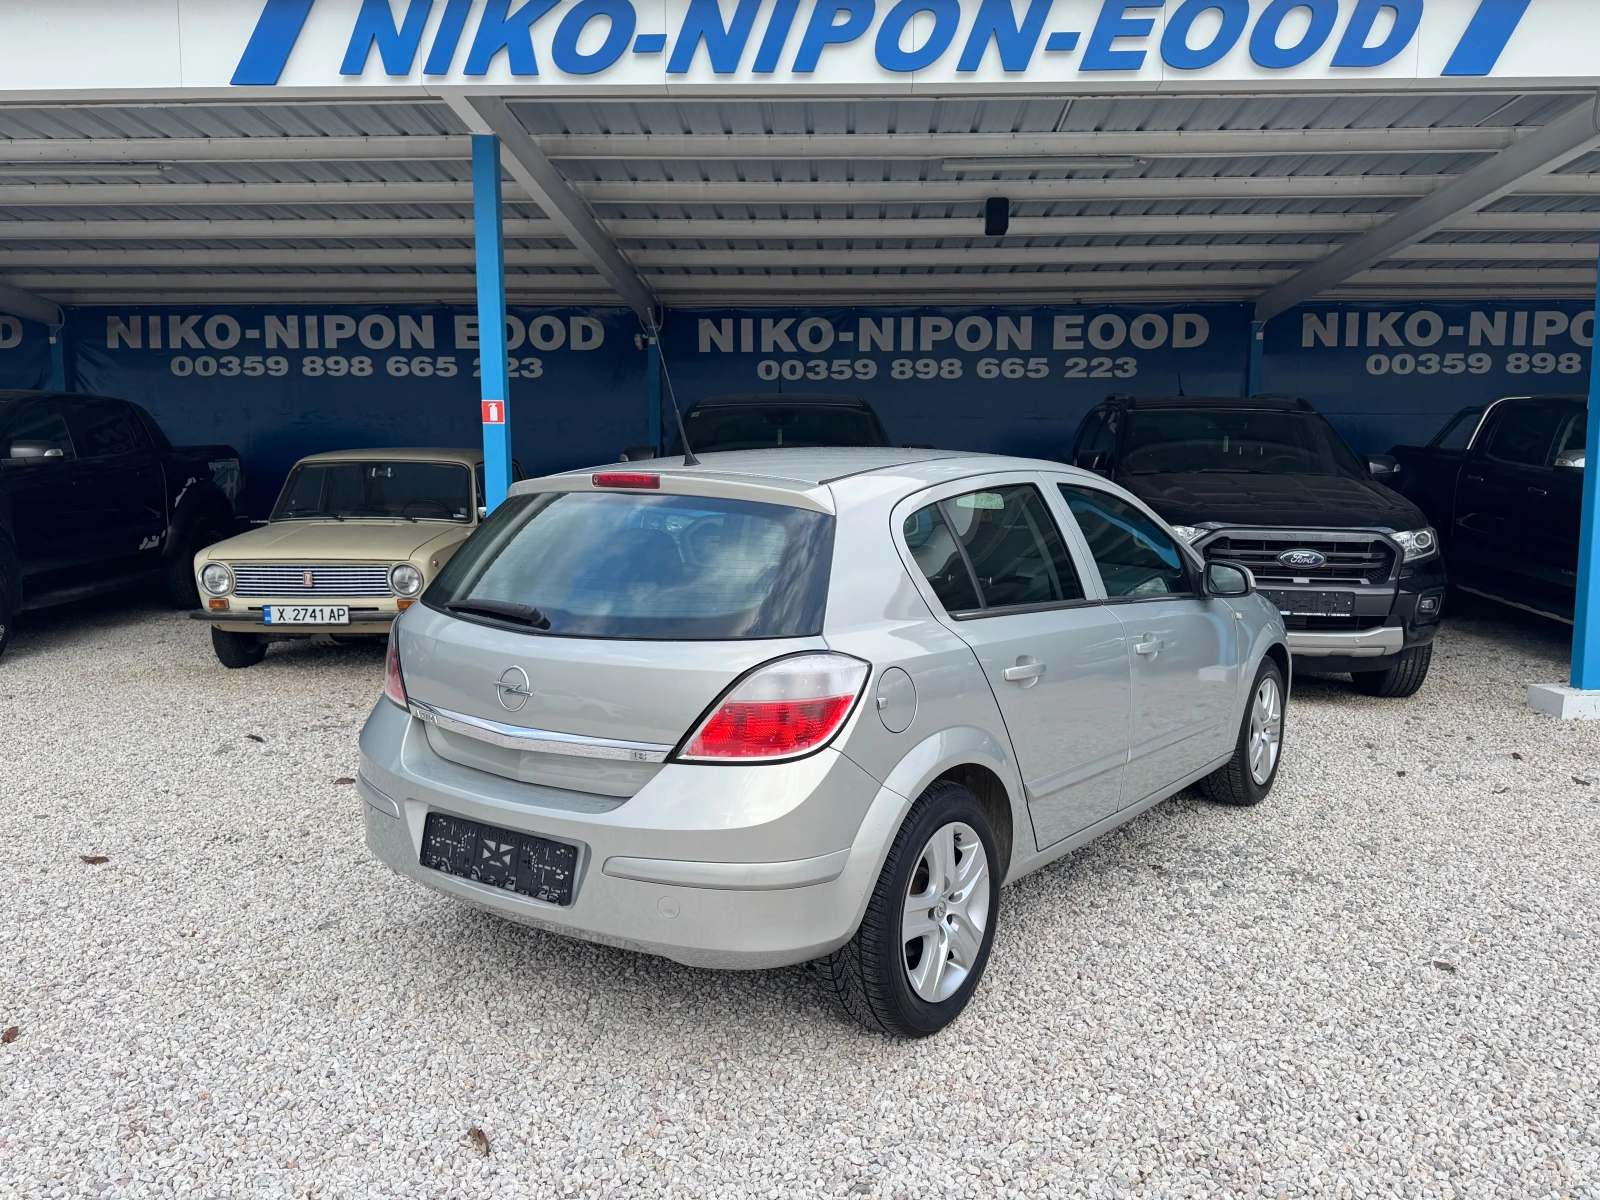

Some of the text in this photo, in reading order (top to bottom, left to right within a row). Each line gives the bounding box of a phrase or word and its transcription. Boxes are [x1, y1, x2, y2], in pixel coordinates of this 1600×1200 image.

[340, 0, 1423, 75] NIKO-NIPON-EOOD
[106, 314, 434, 349] NIKO-NIPON
[698, 313, 1209, 352] NIKO-NIPON EOOD
[1302, 311, 1595, 347] NIKO-NIPO
[170, 356, 289, 377] 00359
[302, 356, 374, 377] 898
[386, 356, 458, 377] 665
[757, 356, 1138, 380] 00359 898 665 223
[1366, 353, 1582, 375] 00359 898
[1290, 553, 1316, 564] Ford
